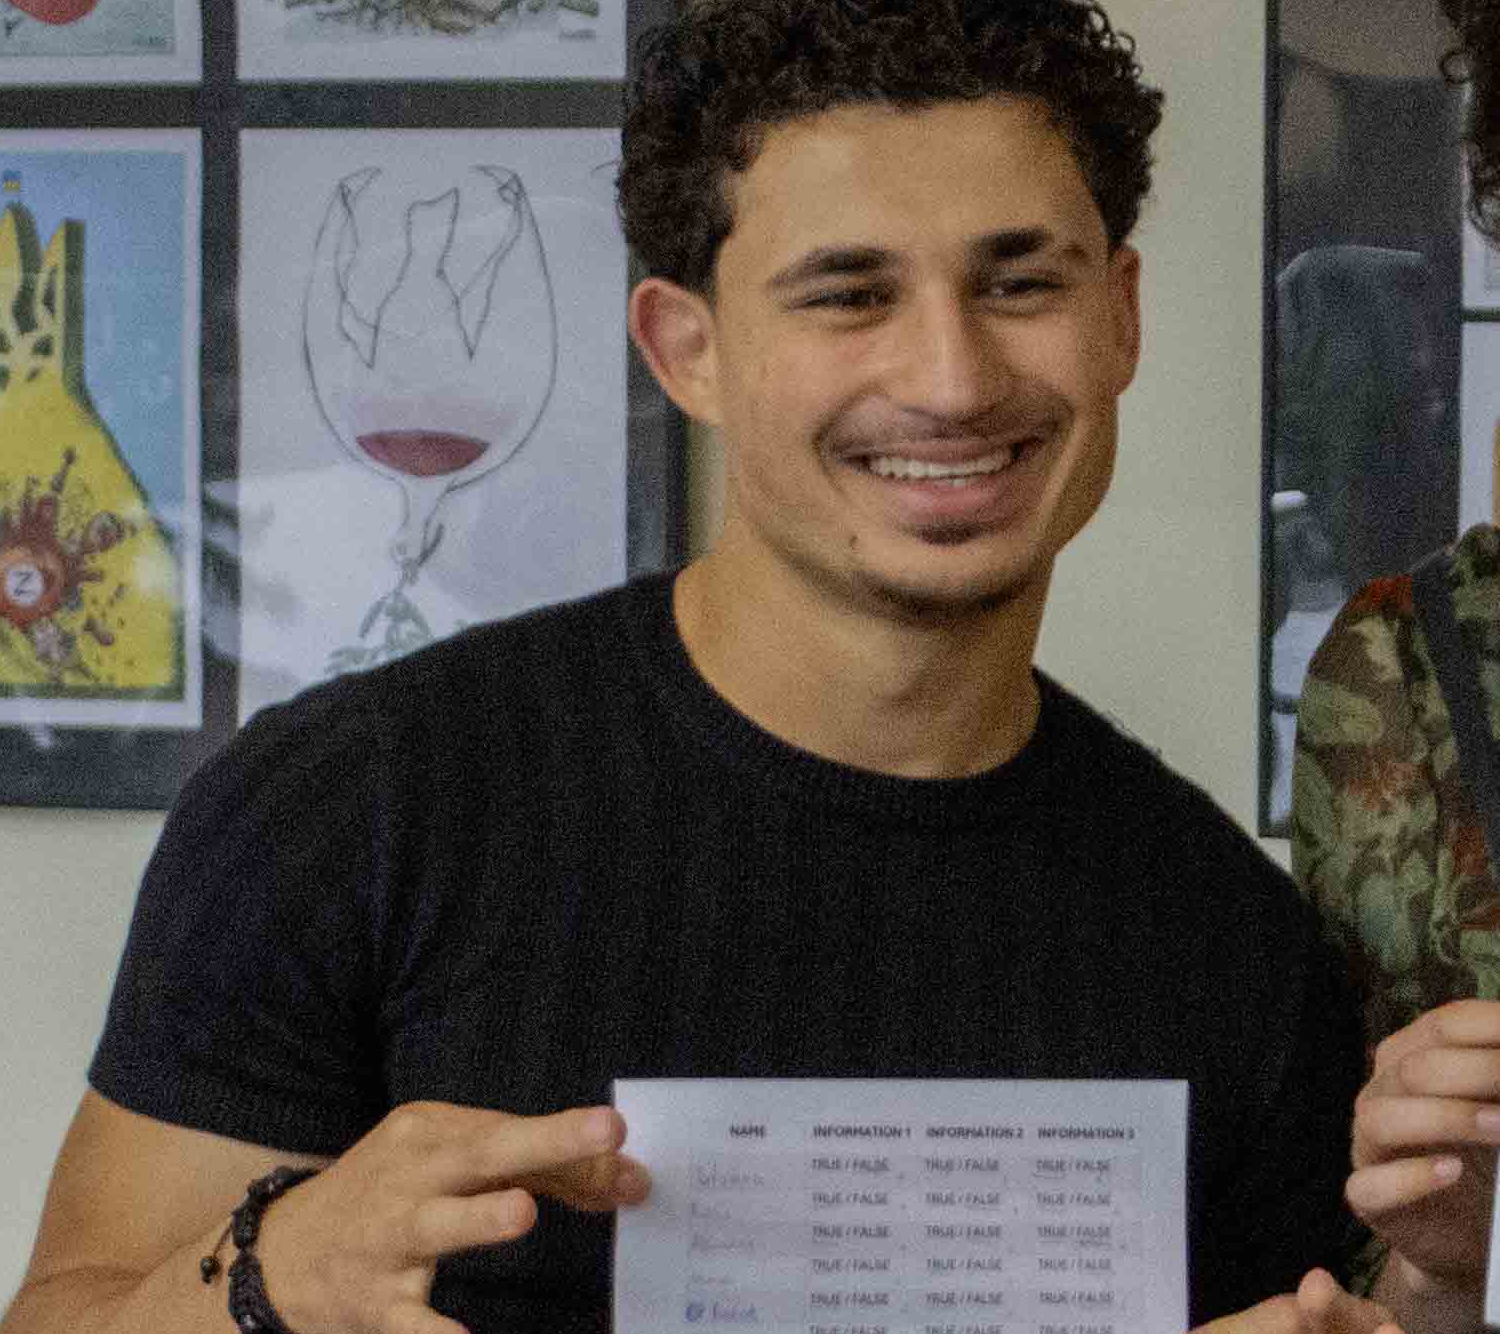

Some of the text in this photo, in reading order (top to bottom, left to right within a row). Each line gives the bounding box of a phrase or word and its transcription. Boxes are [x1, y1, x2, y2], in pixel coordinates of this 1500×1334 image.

[729, 1125, 767, 1138] NAME
[813, 1125, 901, 1138] INFORMATION
[926, 1126, 1013, 1139] INFORMATION
[1038, 1126, 1125, 1139] INFORMATION
